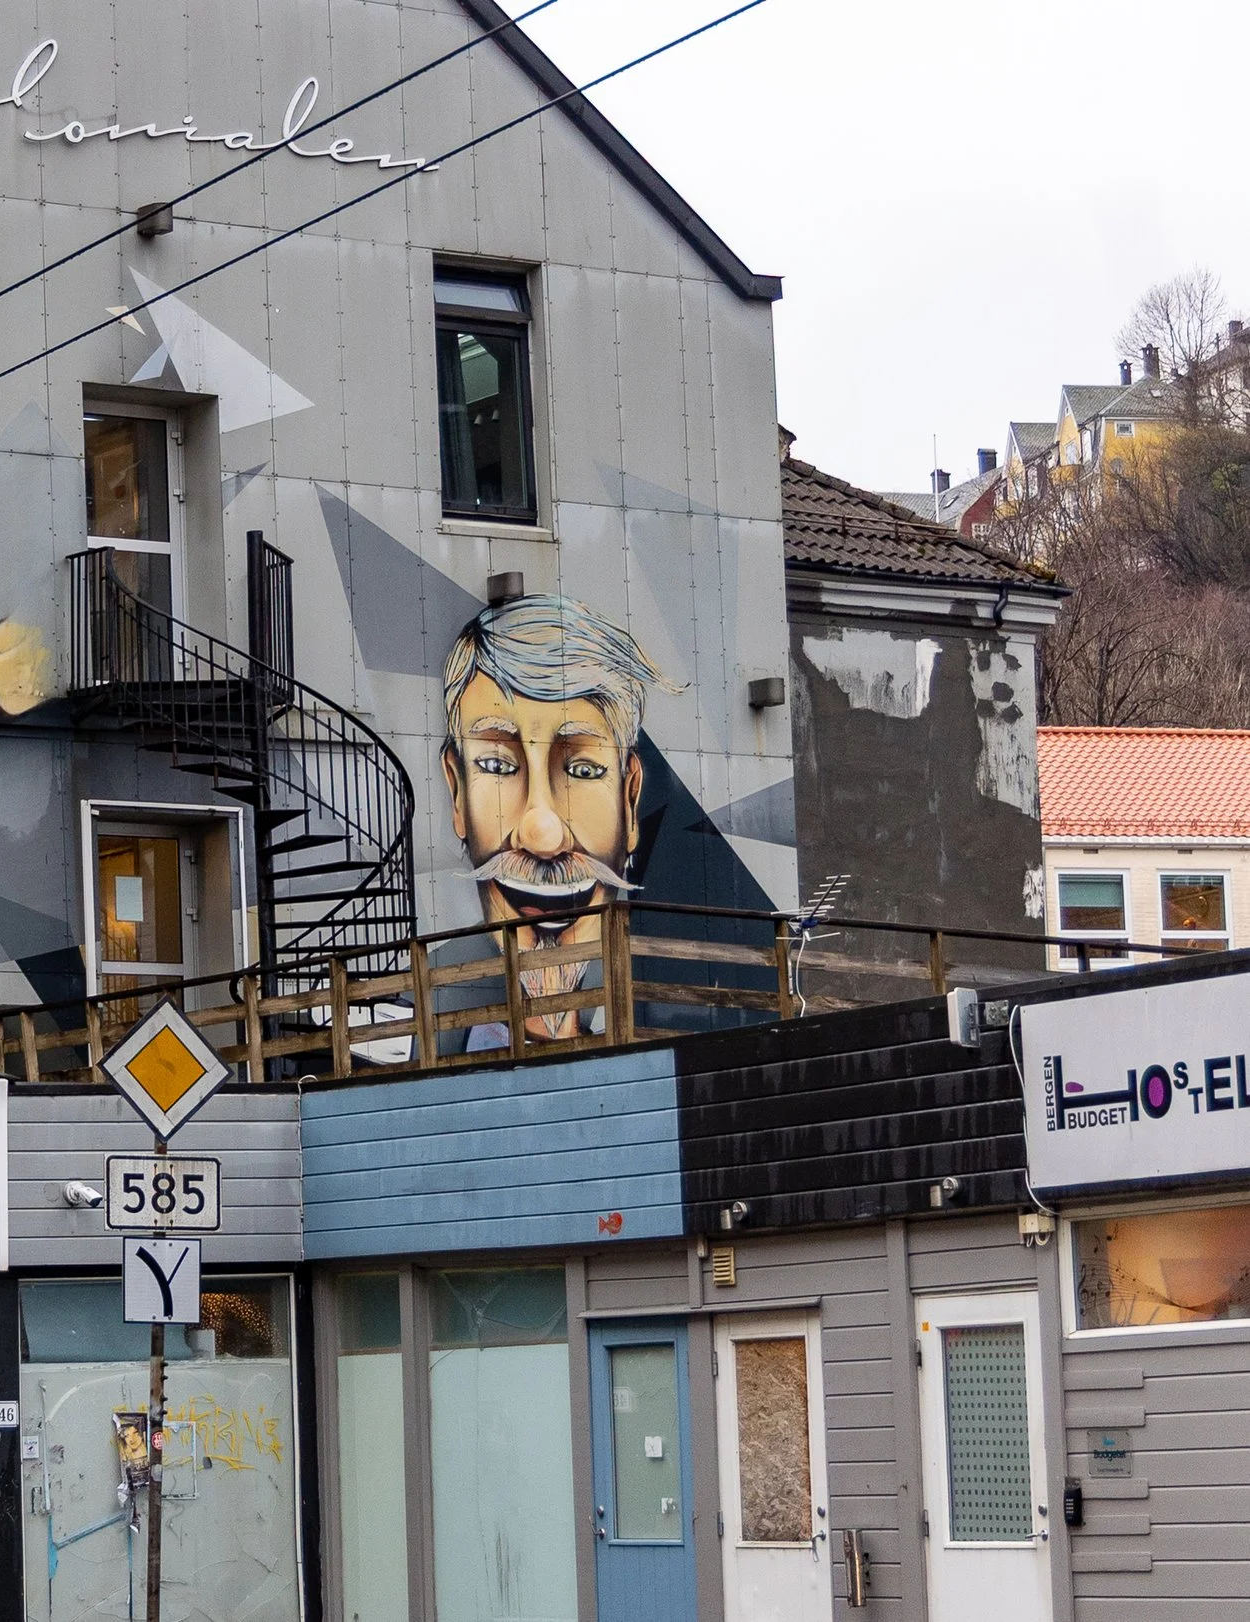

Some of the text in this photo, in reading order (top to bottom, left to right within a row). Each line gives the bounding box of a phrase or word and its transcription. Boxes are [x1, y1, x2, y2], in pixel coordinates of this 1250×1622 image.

[1043, 1055, 1056, 1132] BERGEN
[1067, 1107, 1128, 1130] BUDGET
[123, 1172, 205, 1215] 585
[0, 1407, 14, 1422] 46
